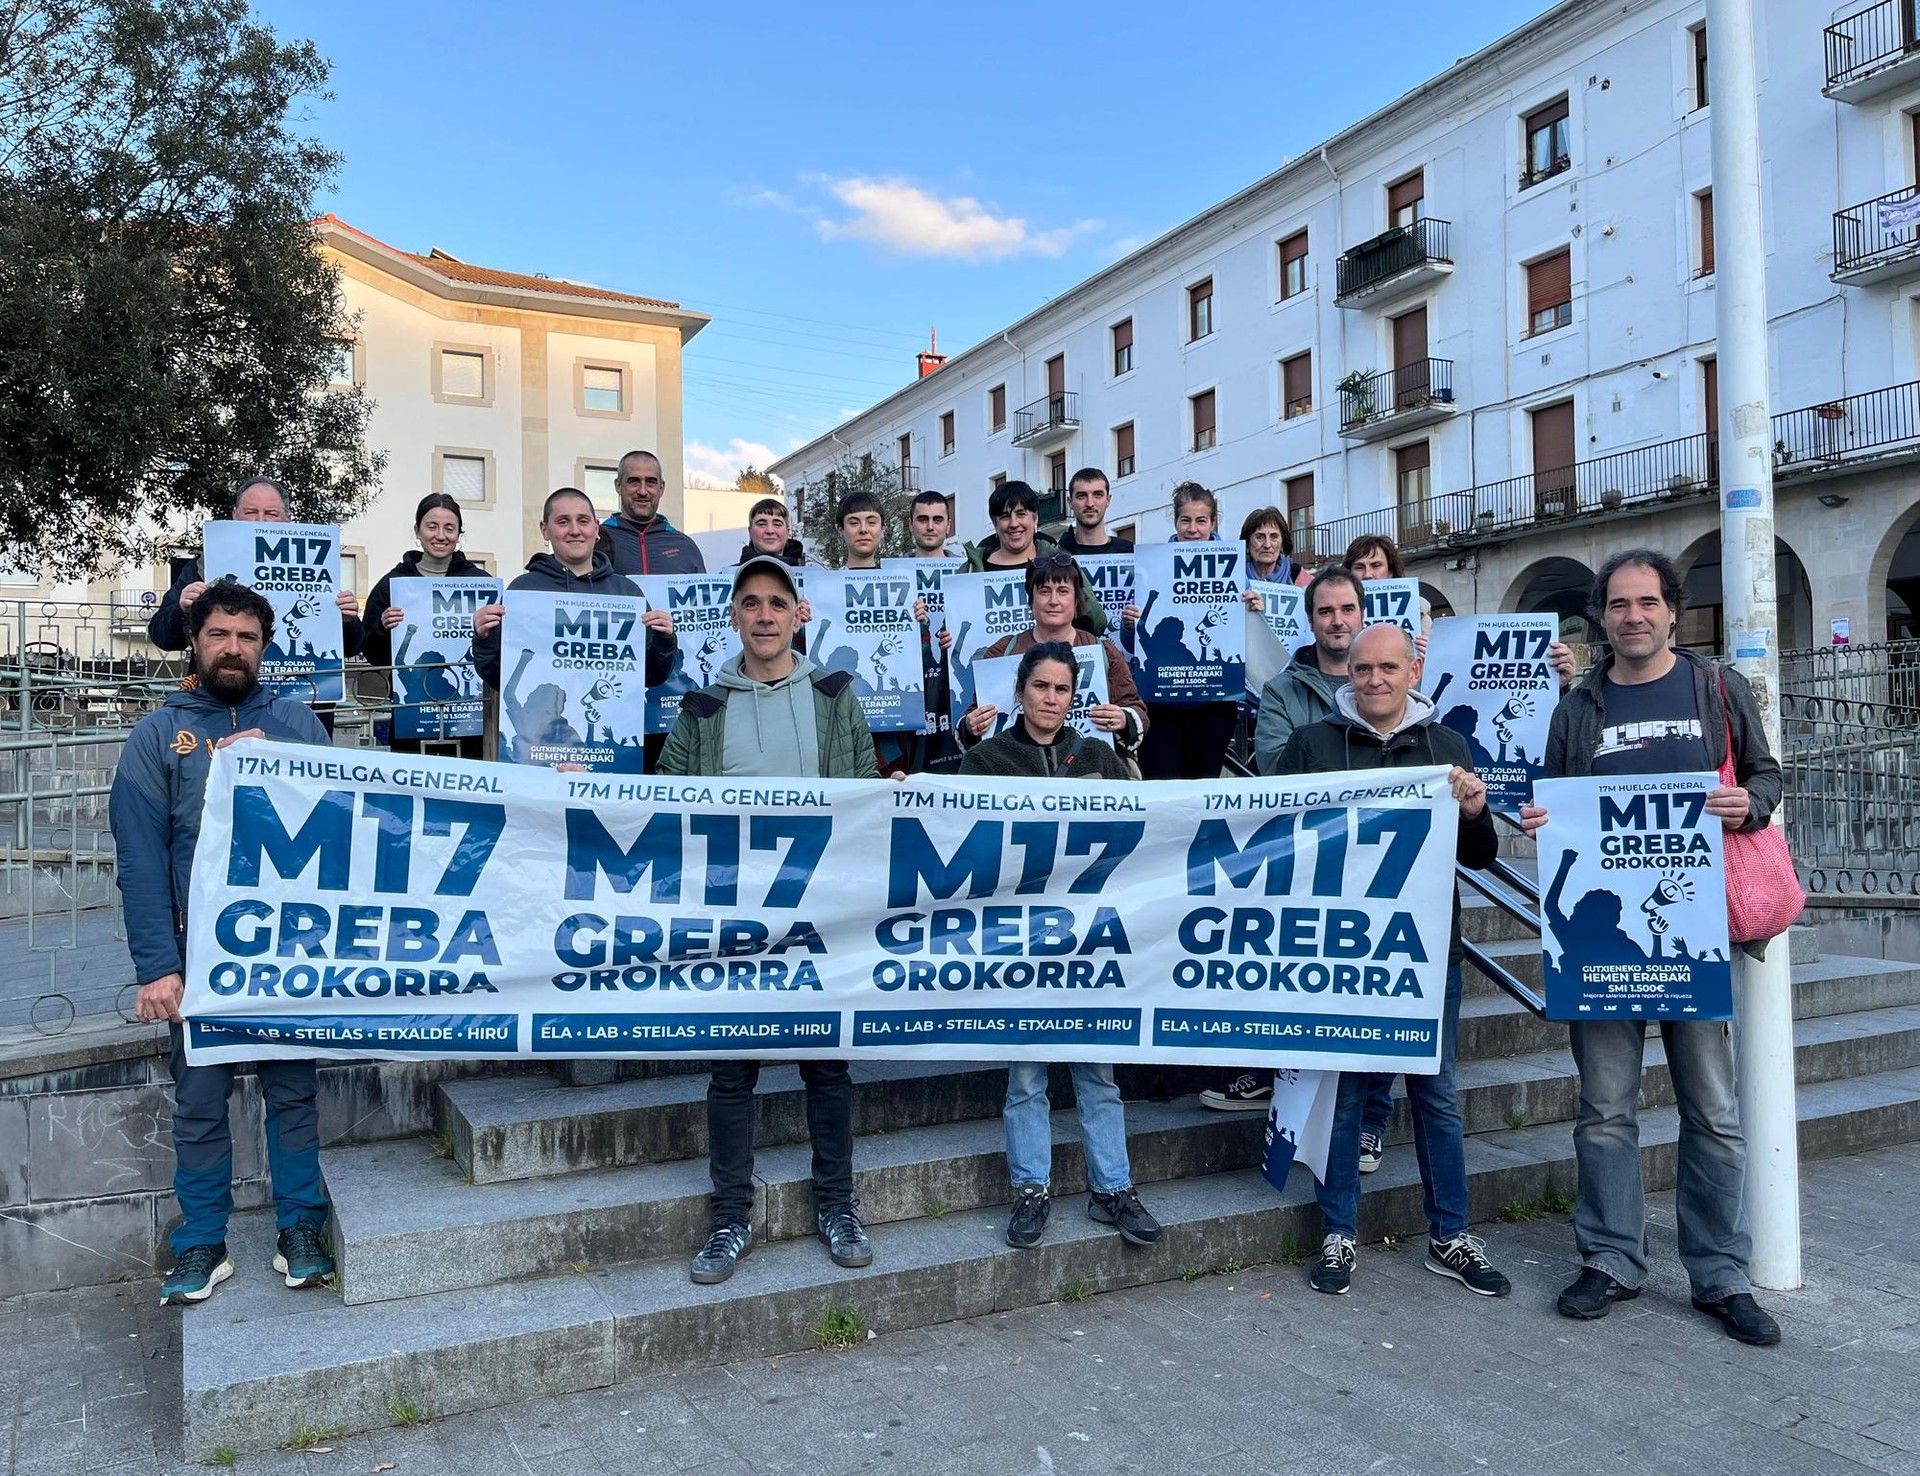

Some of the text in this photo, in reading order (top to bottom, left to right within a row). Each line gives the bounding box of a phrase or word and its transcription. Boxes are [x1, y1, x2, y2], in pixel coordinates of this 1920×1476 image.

[255, 536, 331, 565] M17
[254, 566, 333, 583] GREBA
[1174, 554, 1238, 579] M17
[254, 582, 332, 592] OROKORRA
[668, 584, 732, 608] M17
[845, 582, 910, 607] M17
[984, 581, 1027, 609] M1
[1093, 589, 1135, 602] REBA
[1172, 581, 1239, 595] GREBA
[432, 590, 498, 614] M17
[571, 600, 600, 608] HUELGA
[602, 602, 636, 610] GENERAL
[1172, 595, 1238, 604] OROKORRA
[432, 616, 472, 630] GRE
[555, 608, 637, 641] M17
[671, 606, 732, 623] GREBA
[845, 609, 913, 624] GREBA
[985, 608, 1034, 625] GREB
[432, 630, 474, 639] OROKO
[845, 624, 913, 633] OROKORRA
[985, 622, 1035, 634] OROKOR
[553, 641, 637, 661] GREBA
[1474, 630, 1551, 660] M17
[552, 659, 636, 672] OROKORRA
[1470, 663, 1551, 679] GREBA
[1468, 680, 1549, 690] OROKORRA
[531, 752, 614, 762] HEMEN ERABAKI
[237, 757, 503, 793] 17M HUELGA GENERAL
[1481, 774, 1526, 782] ERABAKI
[568, 781, 832, 807] 17M HUELGA GENERAL
[1203, 783, 1432, 810] 17M HUELGA GENERAL
[1599, 782, 1705, 793] 17M HUELGA GENERAL
[893, 791, 1146, 812] 17M HUELGA GENERAL
[1599, 792, 1707, 832] M17
[226, 785, 507, 896] M17
[1600, 833, 1712, 856] GREBA
[564, 808, 833, 908] M17
[887, 817, 1146, 909] M17
[1187, 807, 1432, 899] M17
[1601, 855, 1711, 870] OROKORRA
[215, 900, 503, 966] GREBA
[554, 912, 828, 968] GREBA
[874, 905, 1132, 957] GREBA
[1178, 907, 1429, 963] GREBA
[208, 961, 500, 998] OROKORRA
[551, 960, 824, 992] OROKORRA
[872, 959, 1126, 991] OROKORRA
[1172, 959, 1424, 999] OROKORRA
[1583, 973, 1691, 982] HEMEN ERABAKI
[1629, 985, 1665, 993] 1.500€
[295, 1028, 363, 1040] STEILAS
[377, 1027, 453, 1040] ETXALDE
[467, 1027, 509, 1040] HIRU
[541, 1023, 832, 1039] ELA LAB STEILAS ETXALDE HIRU
[862, 1018, 1132, 1033] ELA LAB STEILAS ETXALDE HIRU
[1161, 1020, 1431, 1042] ELA LAB STEILAS ETXALDE HIRU
